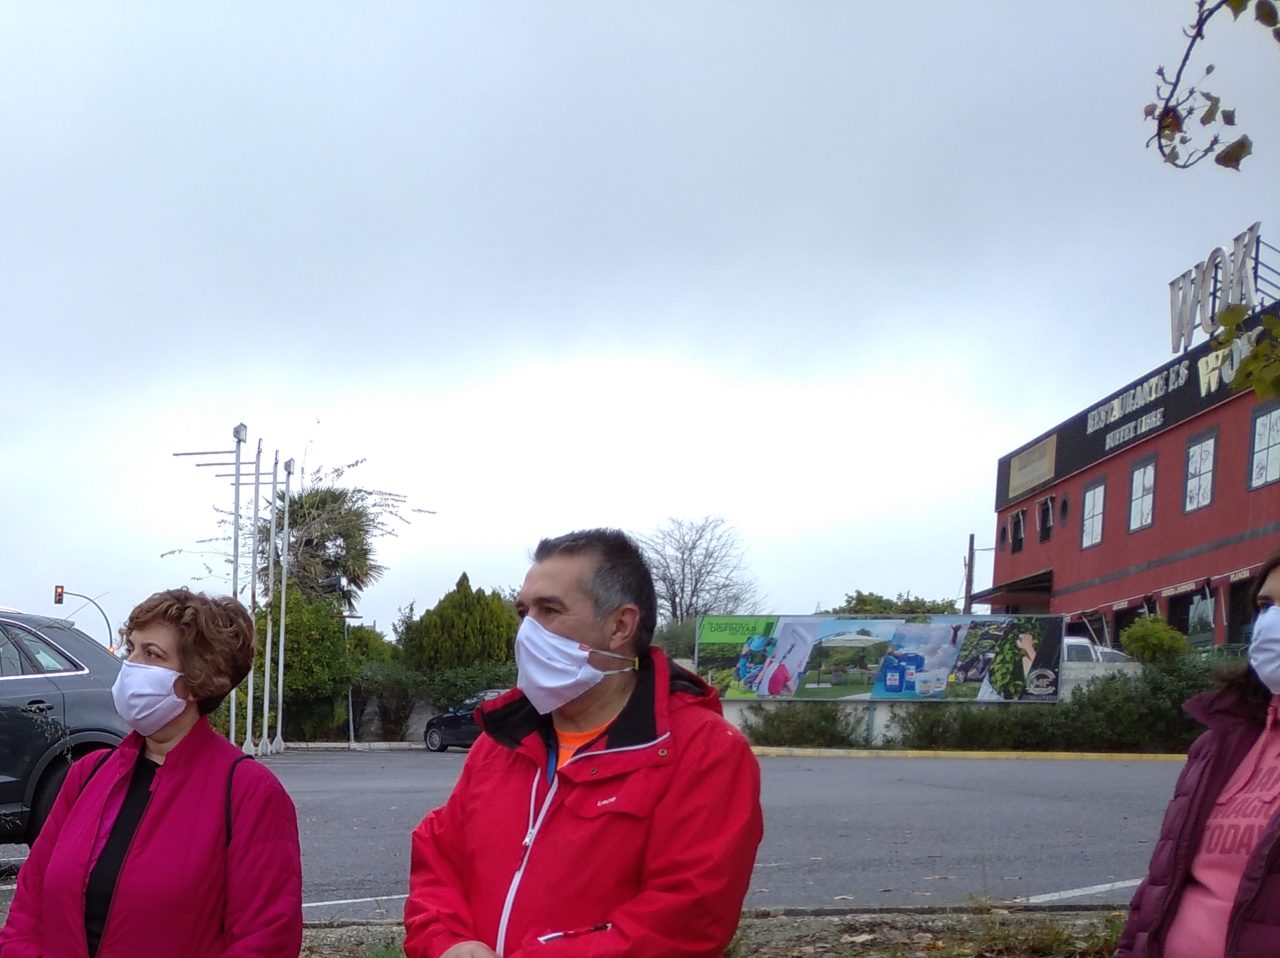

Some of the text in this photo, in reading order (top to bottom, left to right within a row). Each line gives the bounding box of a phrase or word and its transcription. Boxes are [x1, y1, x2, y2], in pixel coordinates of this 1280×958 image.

[1169, 221, 1261, 353] WOK
[1086, 371, 1168, 434] RESTAURANTE
[1168, 360, 1190, 392] ES
